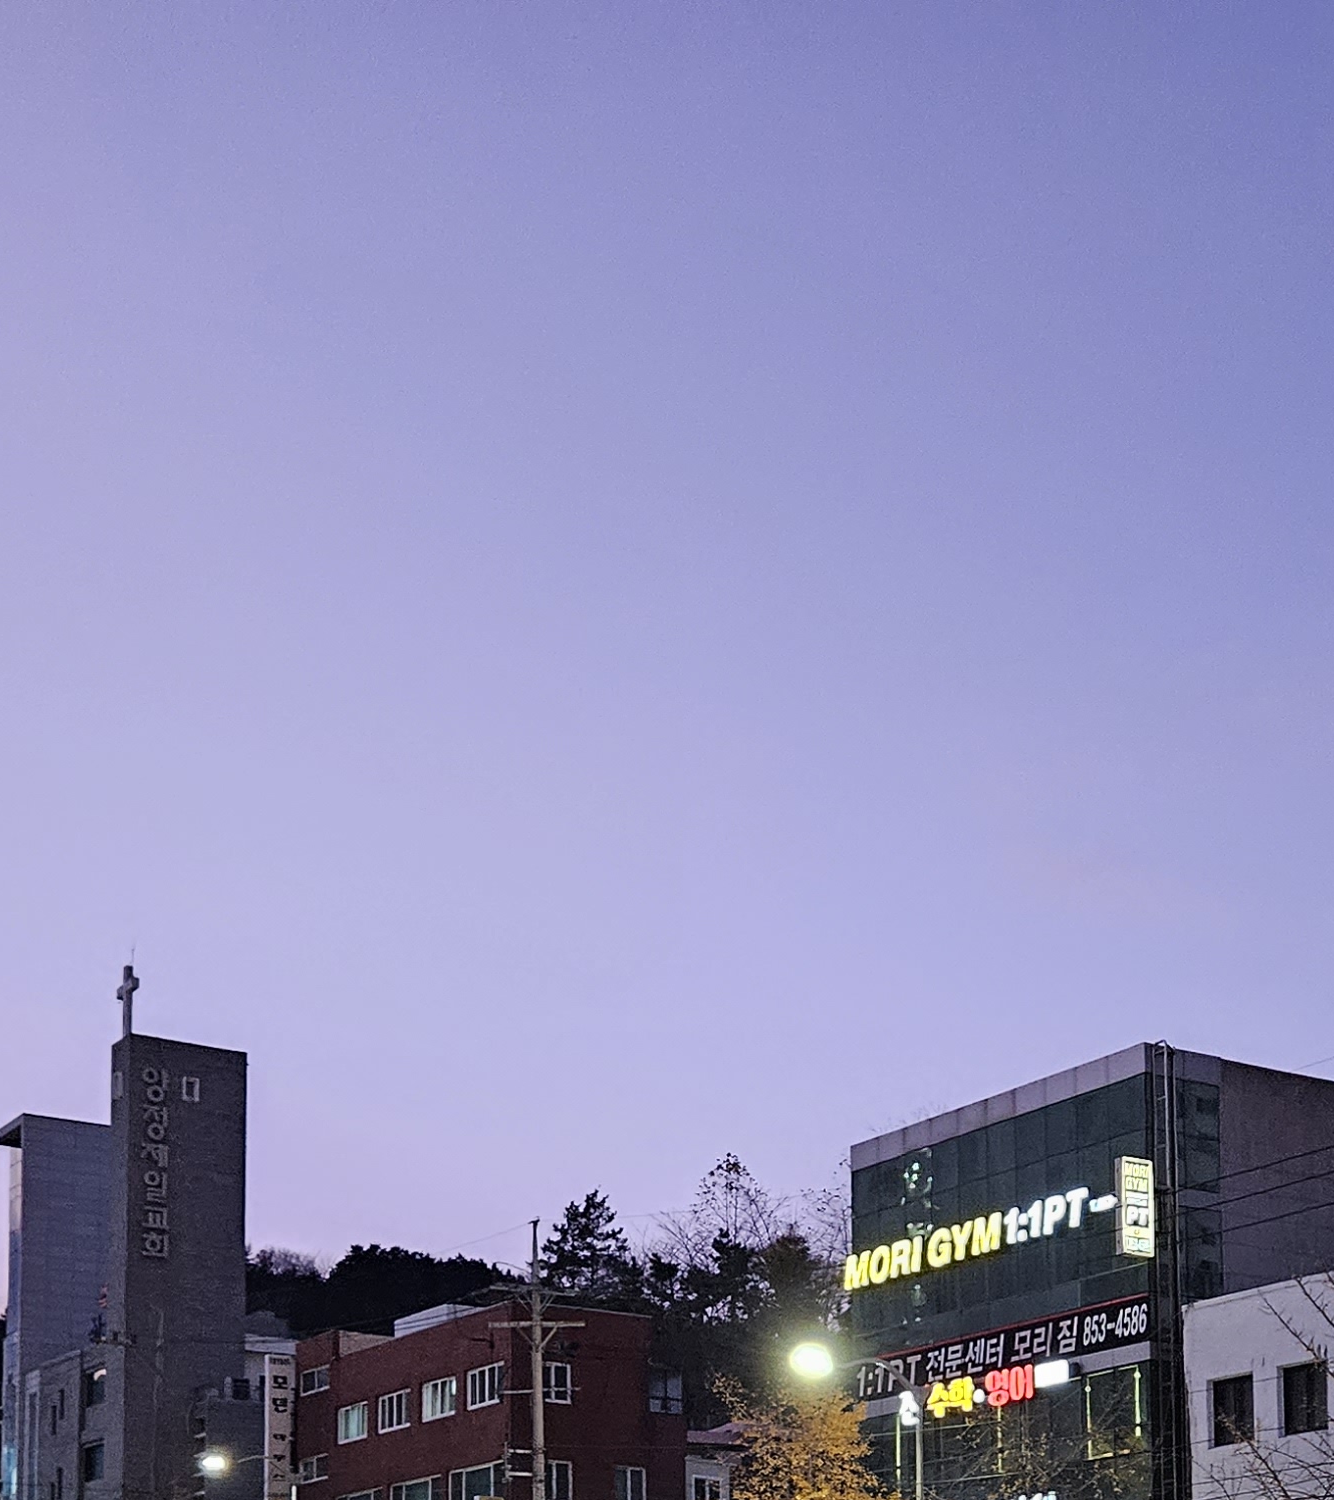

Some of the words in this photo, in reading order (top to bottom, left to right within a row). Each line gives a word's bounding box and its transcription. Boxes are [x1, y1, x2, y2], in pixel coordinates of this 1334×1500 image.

[141, 1066, 170, 1258] 양정제일교회
[843, 1235, 923, 1291] MORI
[927, 1211, 1003, 1268] GYM
[1004, 1187, 1089, 1244] 1:1PT
[1127, 1205, 1150, 1226] PT
[925, 1332, 1005, 1382] 전문센터
[1010, 1324, 1054, 1361] 모리
[1056, 1315, 1078, 1354] 짐
[1083, 1303, 1147, 1346] 853-4586
